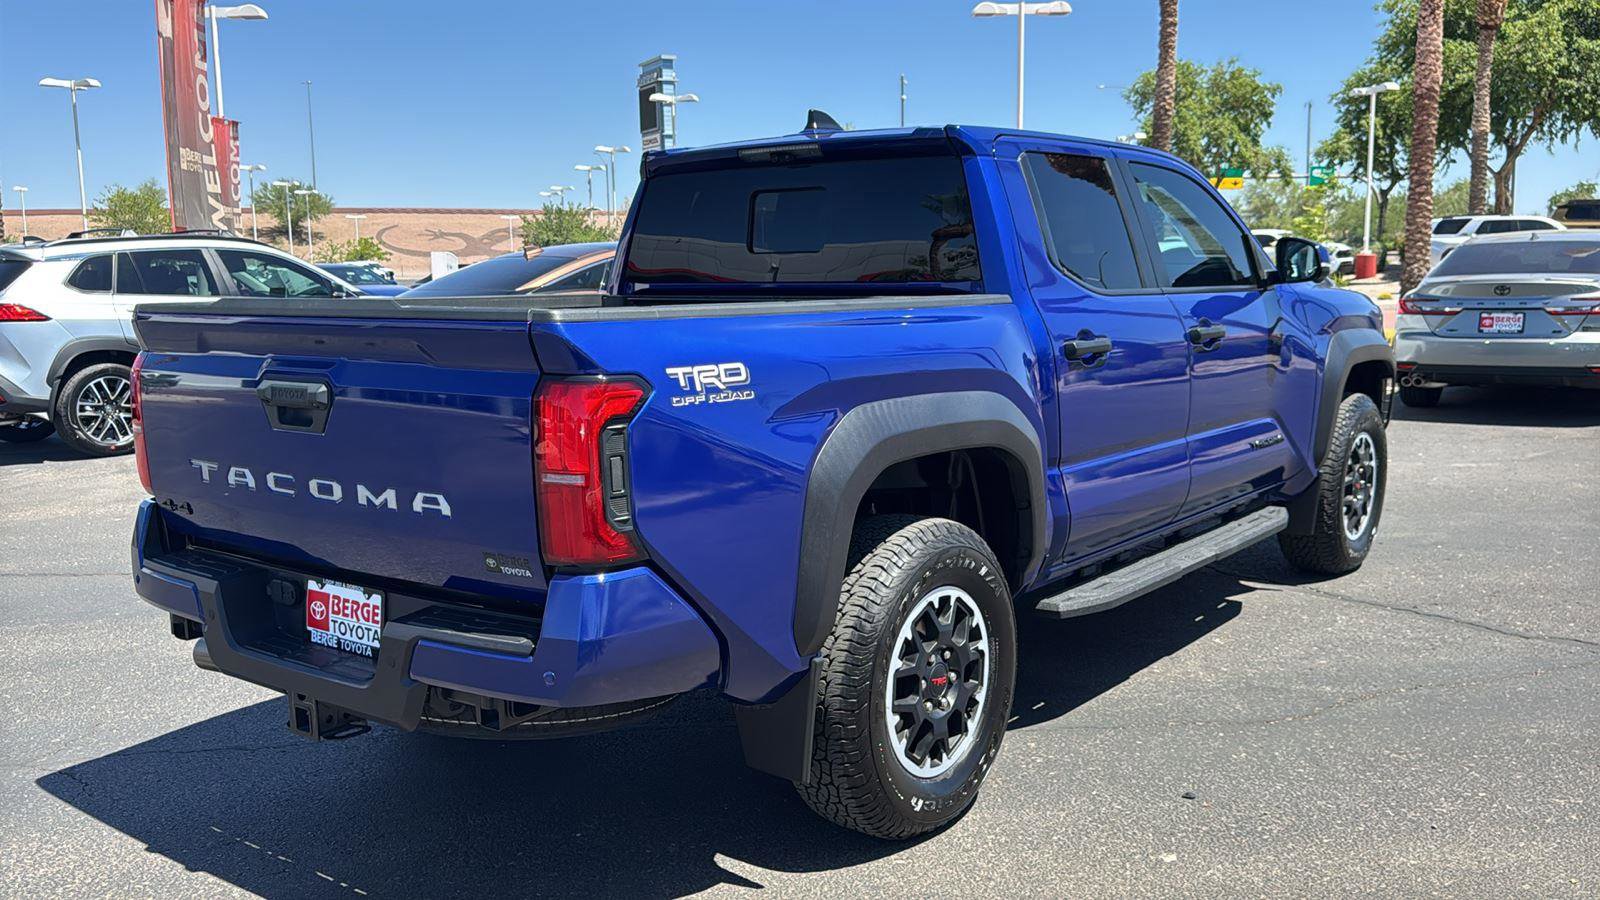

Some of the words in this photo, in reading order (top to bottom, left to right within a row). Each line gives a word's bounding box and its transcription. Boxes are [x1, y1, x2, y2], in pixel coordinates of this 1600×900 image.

[1495, 322, 1522, 330] TOYOTA
[665, 362, 751, 394] TRD
[672, 394, 706, 407] OFF
[708, 390, 755, 404] ROAD
[189, 458, 452, 519] TACOMA
[500, 566, 533, 578] TOYOTA
[331, 594, 380, 624] BERGE
[311, 629, 338, 648] BERGE
[340, 639, 373, 657] TOYOTA
[331, 619, 380, 643] TOYOTA
